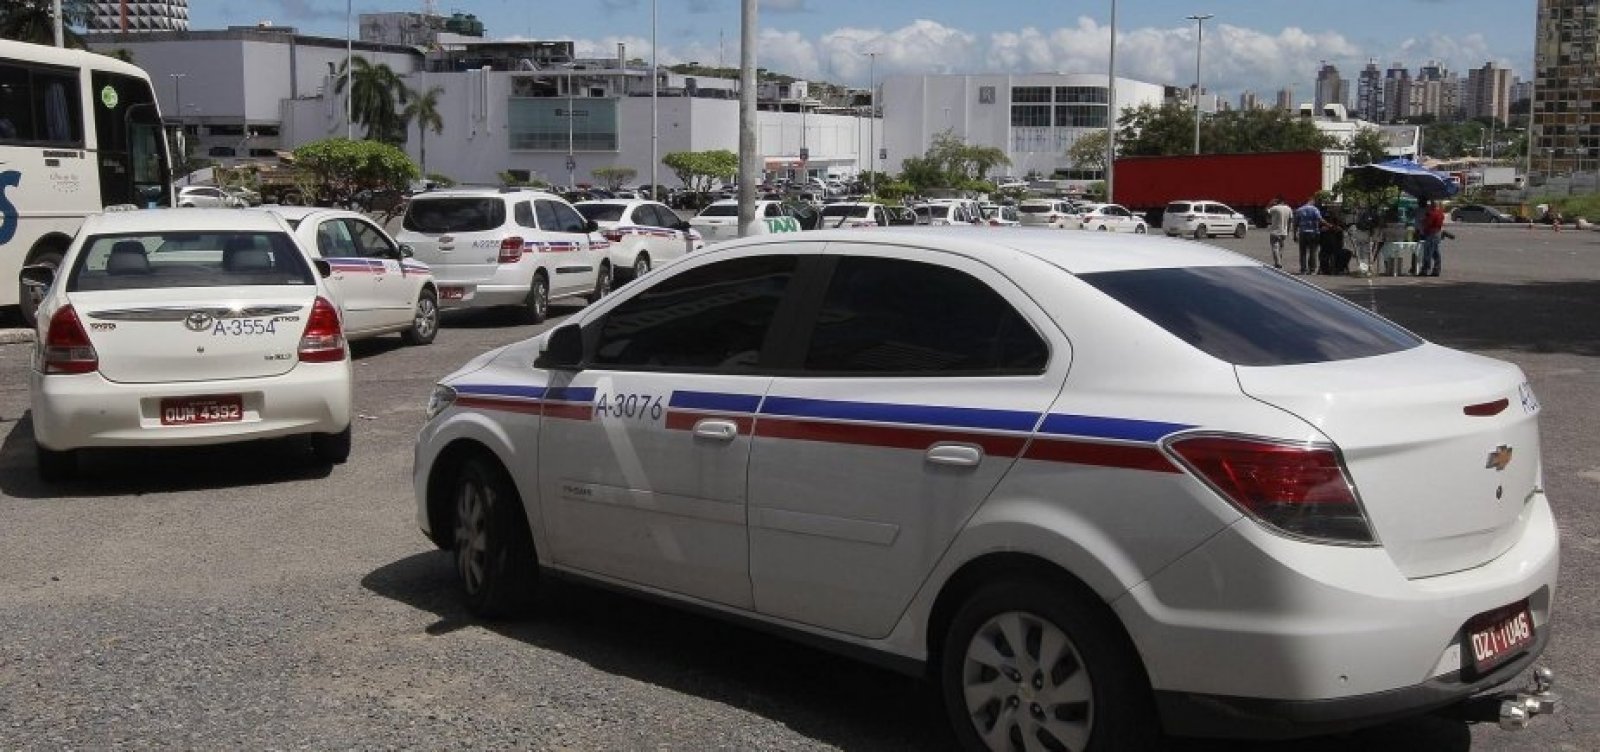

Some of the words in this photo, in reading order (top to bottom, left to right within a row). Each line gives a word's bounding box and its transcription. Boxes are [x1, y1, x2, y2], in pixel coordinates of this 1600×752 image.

[762, 217, 798, 233] TAXI
[212, 319, 275, 336] A-3554
[594, 391, 663, 420] A-3076
